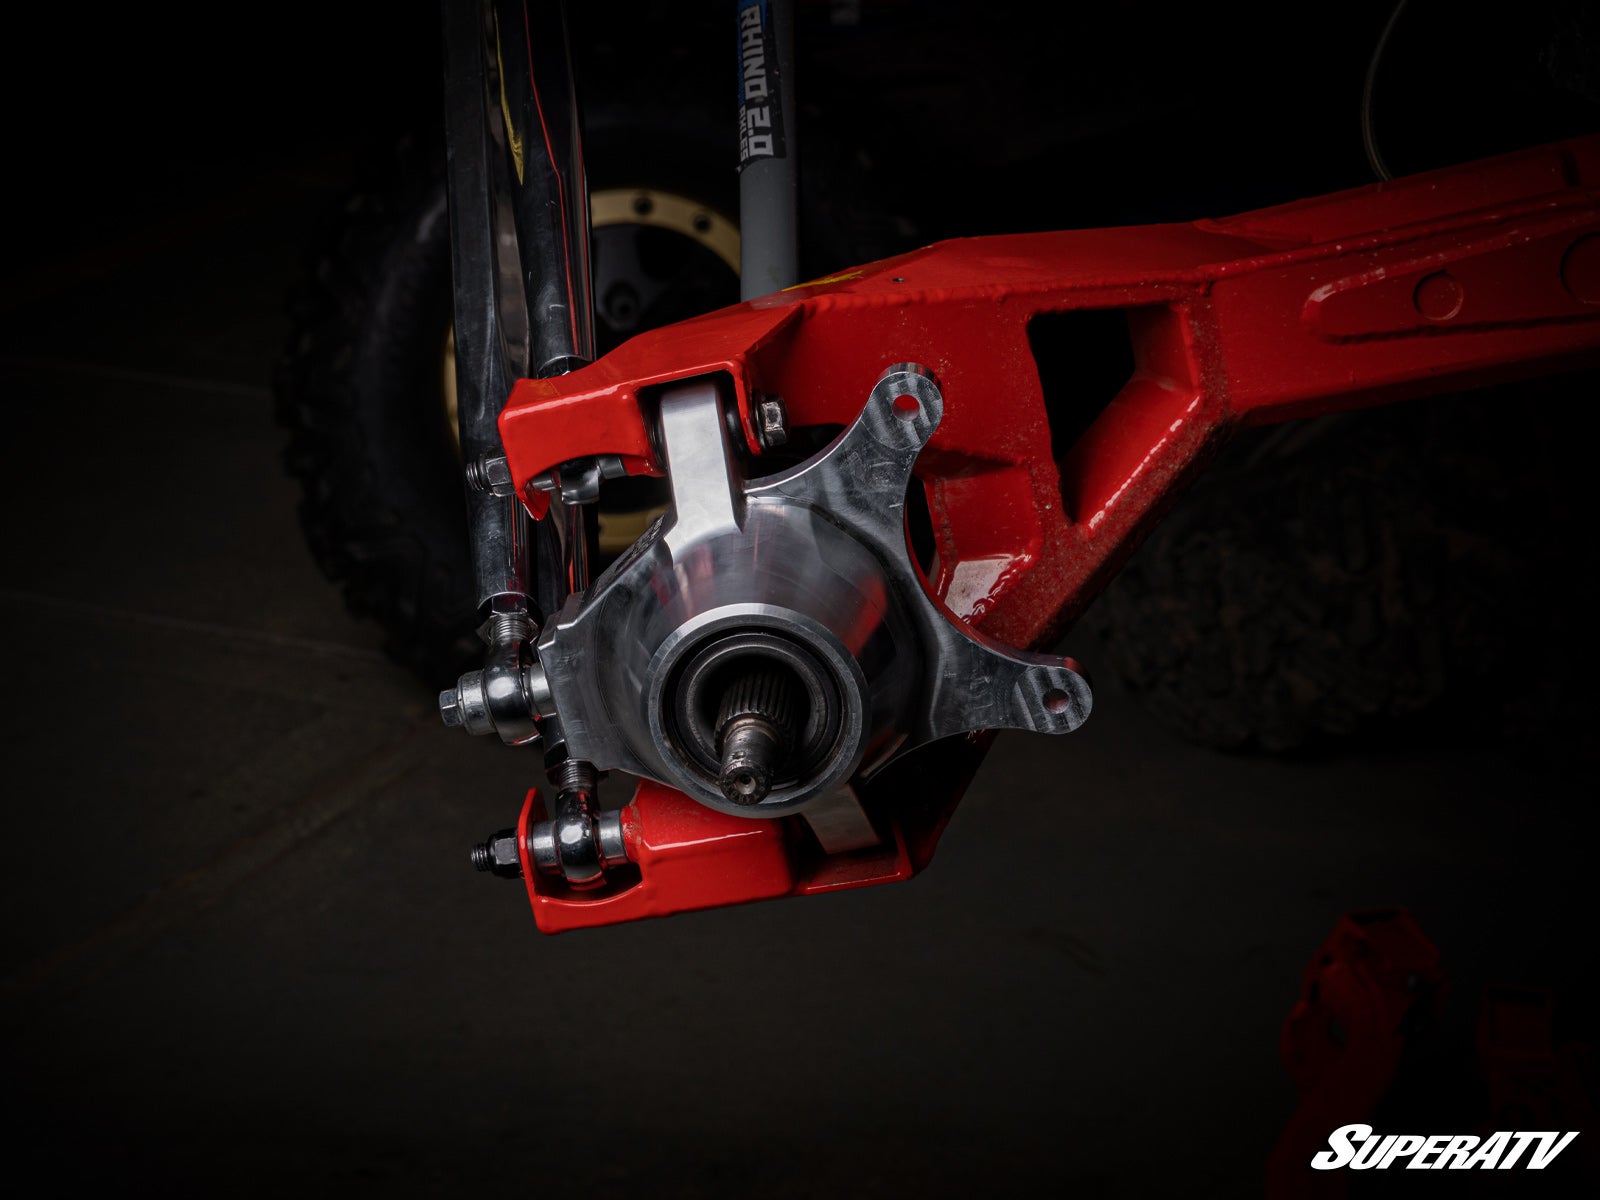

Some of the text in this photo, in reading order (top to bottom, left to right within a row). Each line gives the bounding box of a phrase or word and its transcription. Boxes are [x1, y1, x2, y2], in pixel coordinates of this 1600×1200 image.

[741, 4, 774, 157] RHINO 2.0
[738, 105, 749, 162] AXLES
